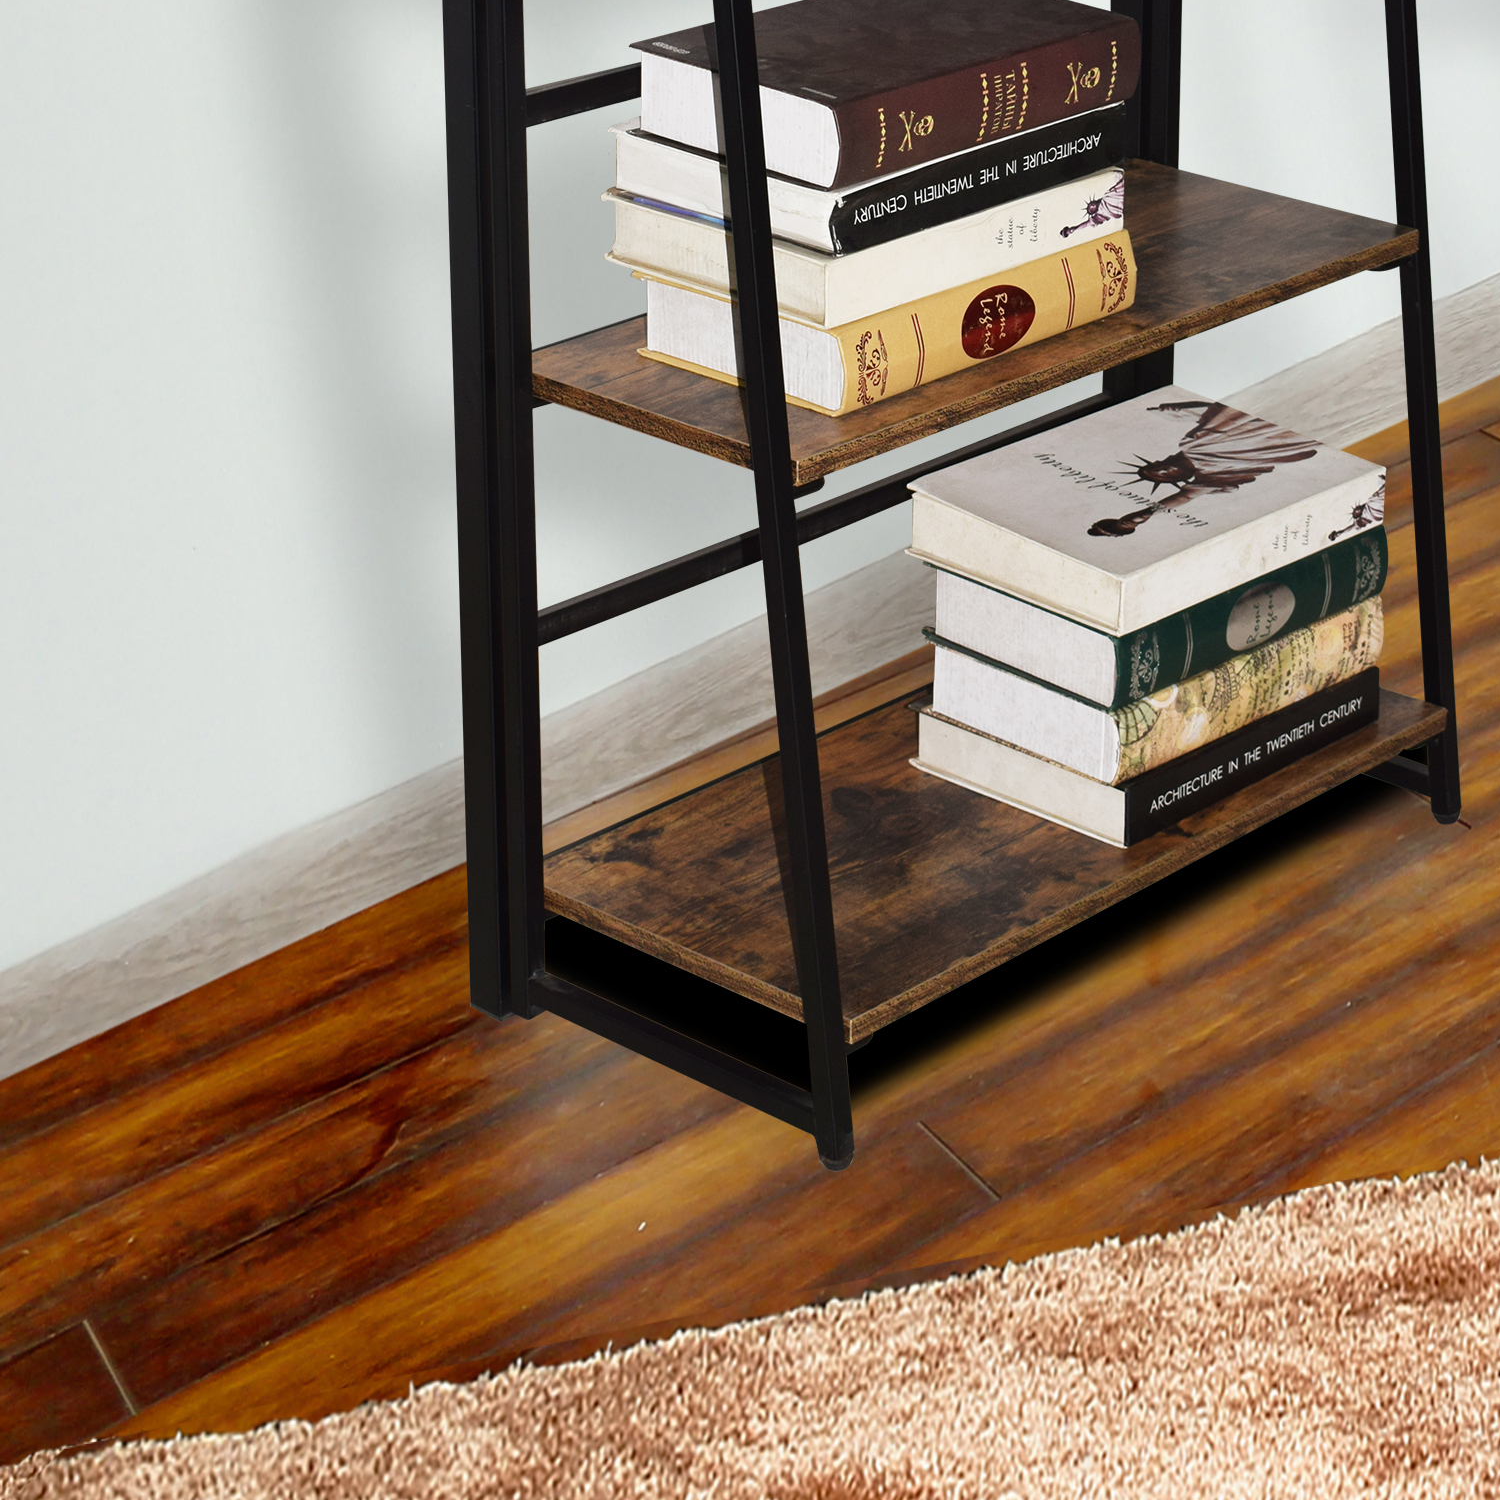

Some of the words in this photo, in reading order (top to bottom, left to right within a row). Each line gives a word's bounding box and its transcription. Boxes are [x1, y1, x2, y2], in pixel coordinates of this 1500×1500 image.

[1005, 160, 1017, 177] IN
[1022, 132, 1102, 172] ARCHITECTURE
[914, 173, 974, 206] TWENTIETH
[979, 165, 1000, 186] THE
[853, 194, 908, 226] CENTURY
[1029, 206, 1042, 243] liberty
[995, 227, 1004, 245] the
[1007, 217, 1015, 249] statue
[1016, 222, 1027, 236] of
[978, 298, 995, 353] Legend
[994, 292, 1008, 340] Rome
[1245, 601, 1260, 645] Rome
[1149, 764, 1223, 814] ARCHITECTURE
[1227, 757, 1239, 775] IN
[1243, 746, 1262, 766] THE
[1266, 720, 1315, 755] TWENTIETH
[1319, 696, 1363, 728] CENTURY
